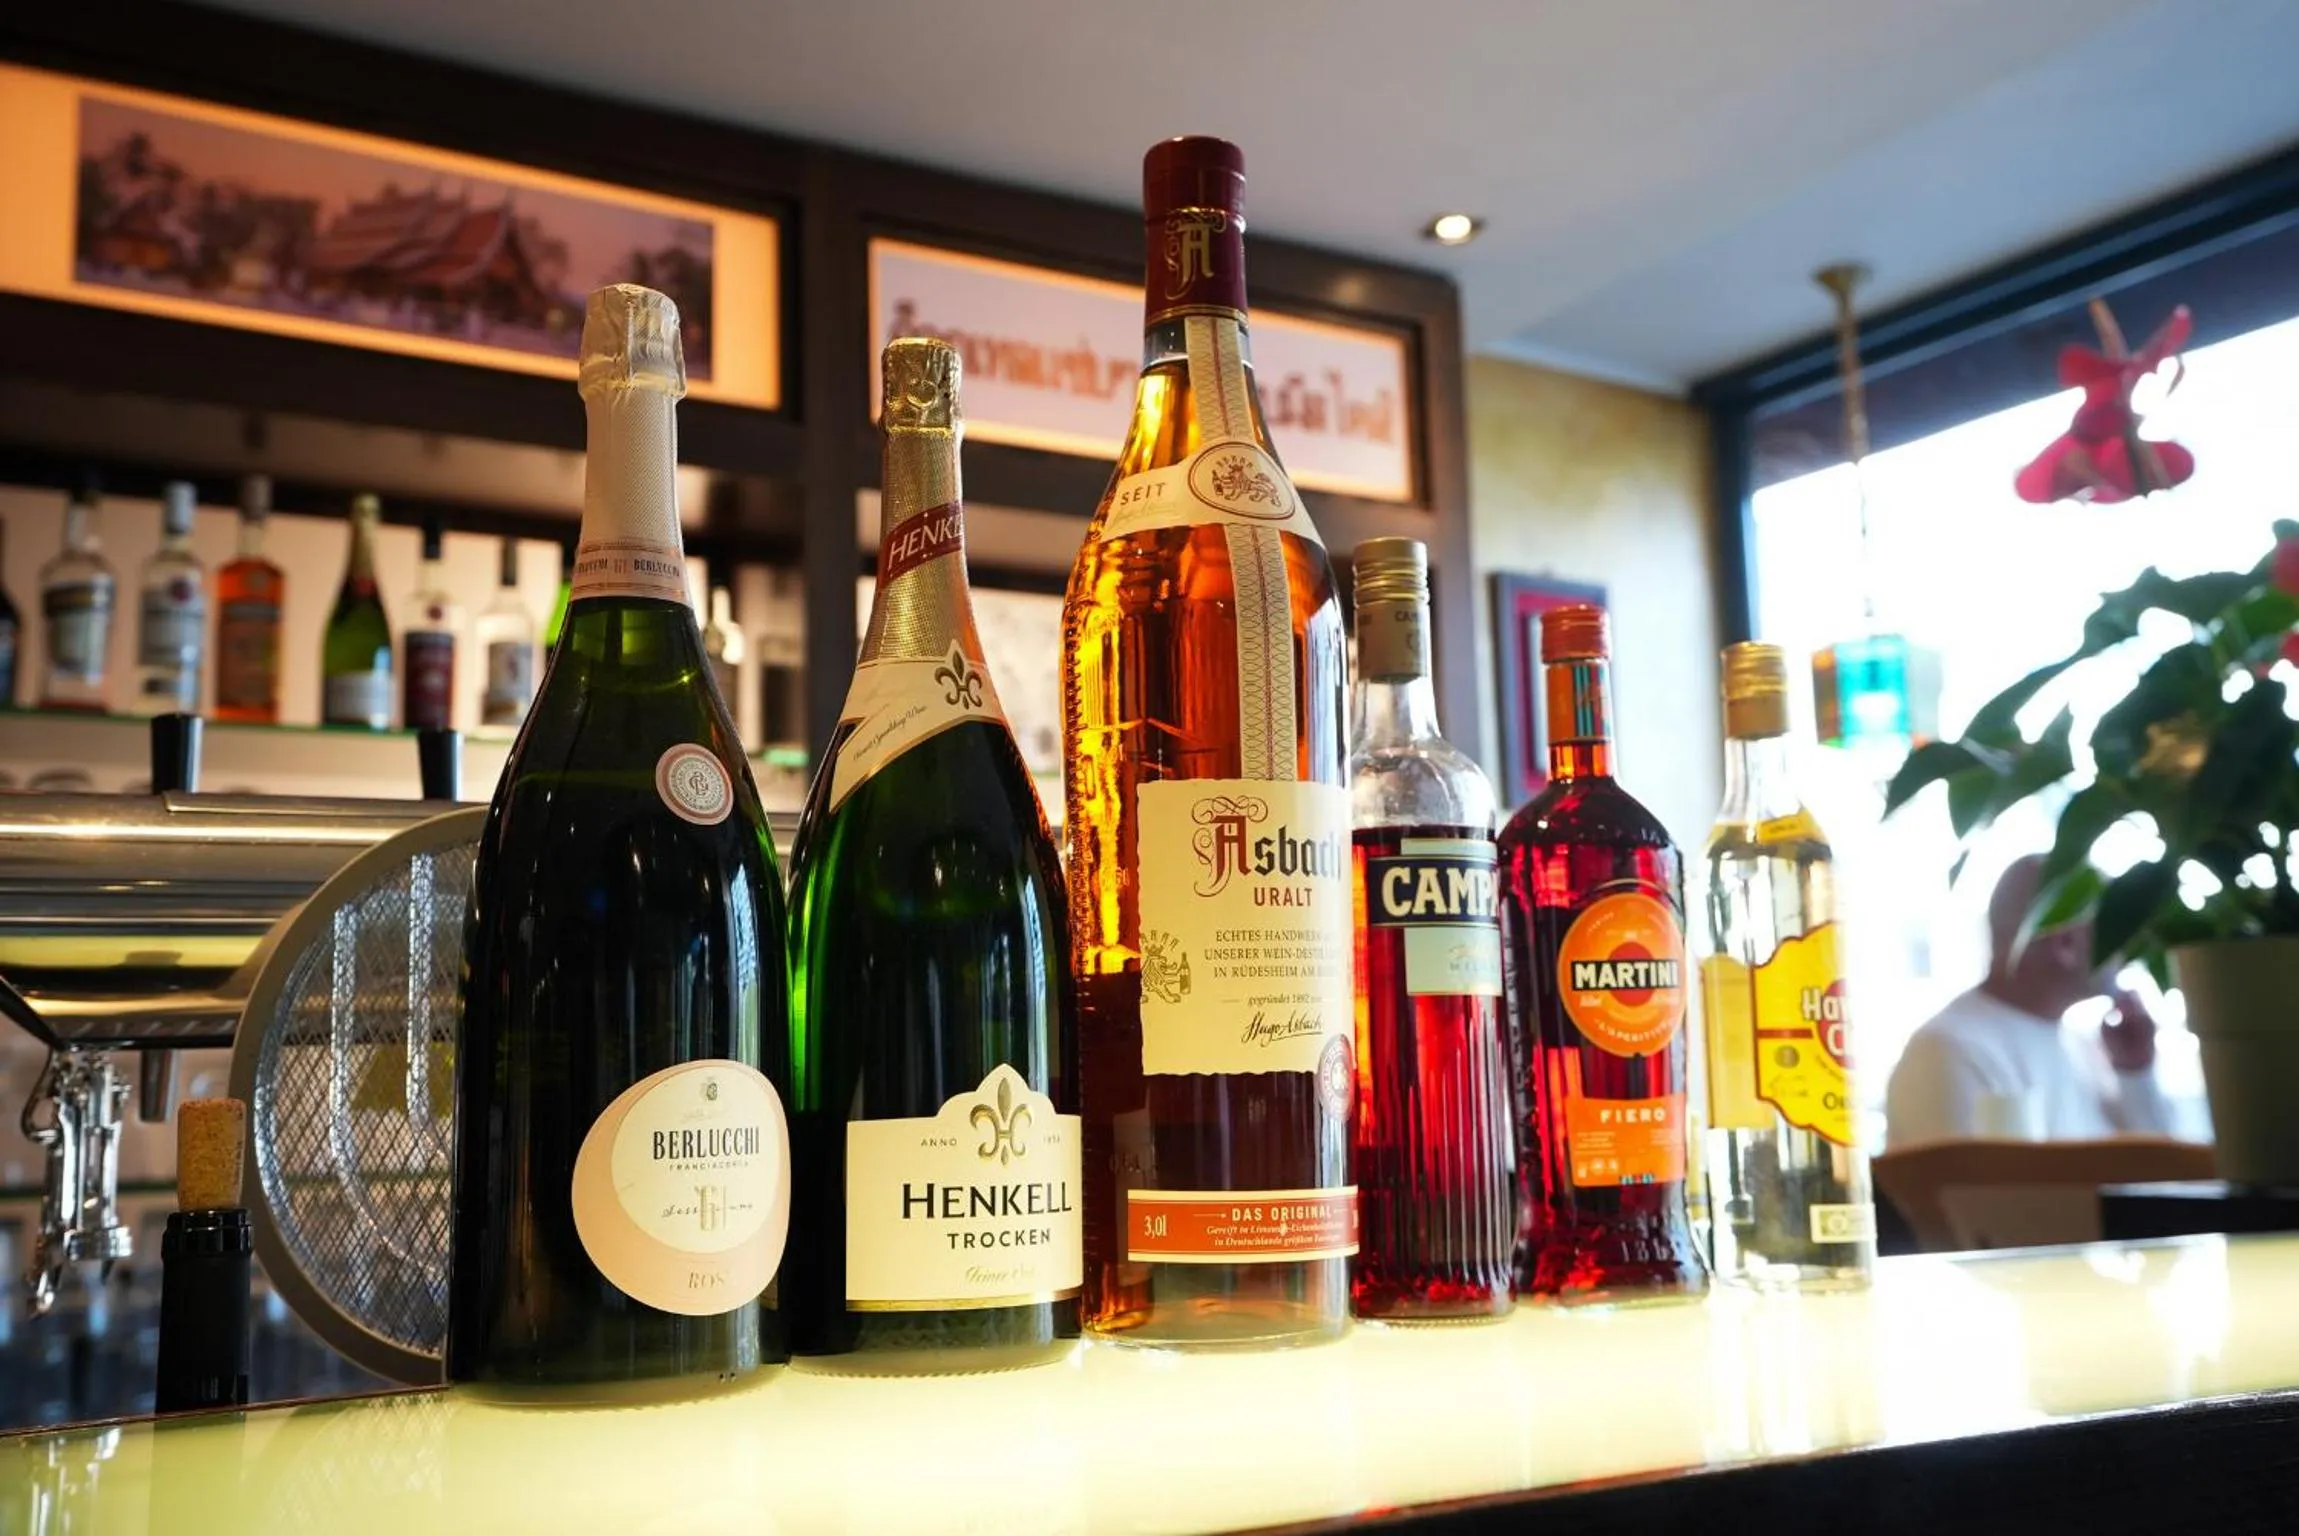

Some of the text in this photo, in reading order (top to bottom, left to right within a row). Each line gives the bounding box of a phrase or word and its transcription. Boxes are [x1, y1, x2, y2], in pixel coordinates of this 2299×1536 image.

[1120, 482, 1166, 506] SEIT
[1192, 796, 1342, 897] Asbach
[1253, 886, 1312, 906] URALT
[1215, 930, 1261, 942] ECHTES
[1204, 948, 1260, 961] UNSERER
[1213, 966, 1227, 978] IN
[1231, 963, 1298, 978] RÜDESHEIM
[1575, 961, 1678, 989] MARTINI
[1600, 1108, 1667, 1123] FIERO
[653, 1126, 760, 1160] BERLUCCHI
[920, 1137, 958, 1148] ANNO
[902, 1181, 1073, 1219] HENKELL
[1232, 1205, 1332, 1221] DAS ORIGINAL
[947, 1228, 1051, 1250] TROCKEN
